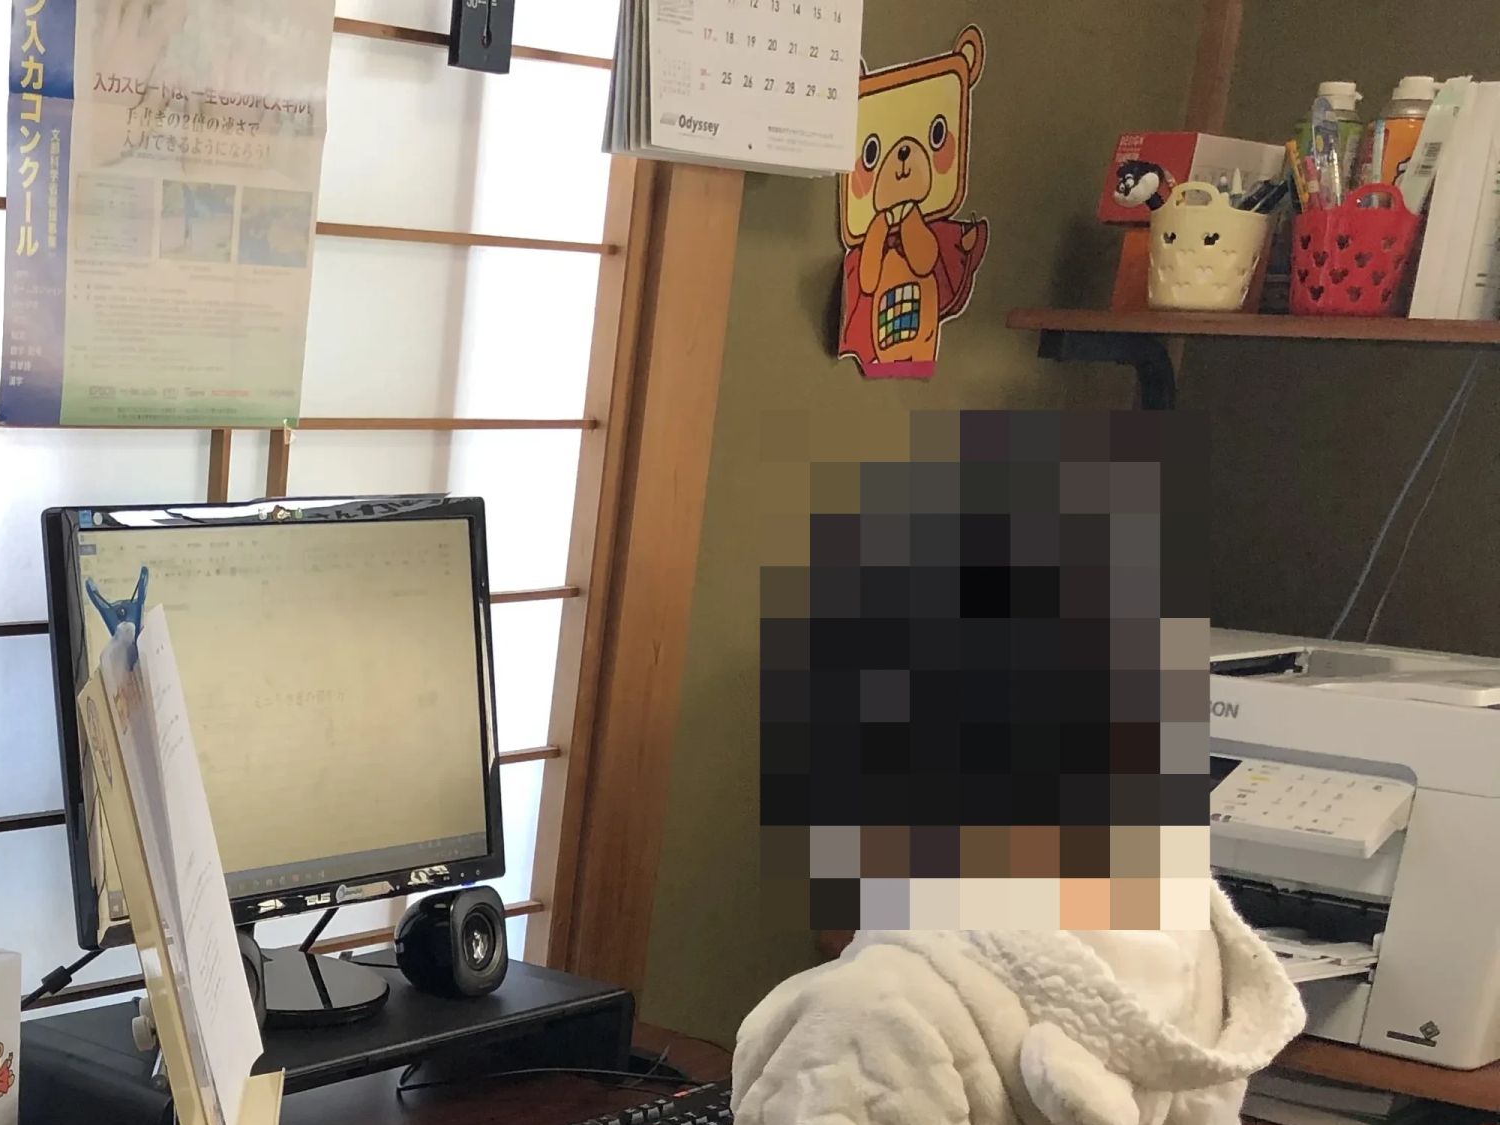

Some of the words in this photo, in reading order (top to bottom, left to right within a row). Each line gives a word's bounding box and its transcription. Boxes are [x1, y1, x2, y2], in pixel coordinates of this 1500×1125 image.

[772, 0, 780, 13] 13
[793, 4, 800, 15] 14
[814, 8, 821, 19] 15
[834, 11, 841, 23] 16
[704, 28, 712, 40] 17
[726, 32, 734, 44] 18
[747, 36, 755, 47] 19
[768, 39, 777, 51] 20
[789, 43, 797, 54] 21
[810, 46, 818, 58] 22
[830, 50, 839, 61] 23
[722, 72, 732, 84] 25
[743, 75, 752, 88] 26
[765, 79, 774, 91] 27
[786, 82, 795, 94] 28
[806, 85, 815, 97] 29
[827, 88, 837, 100] 30
[679, 114, 719, 136] Odyssey
[1210, 701, 1239, 719] ON
